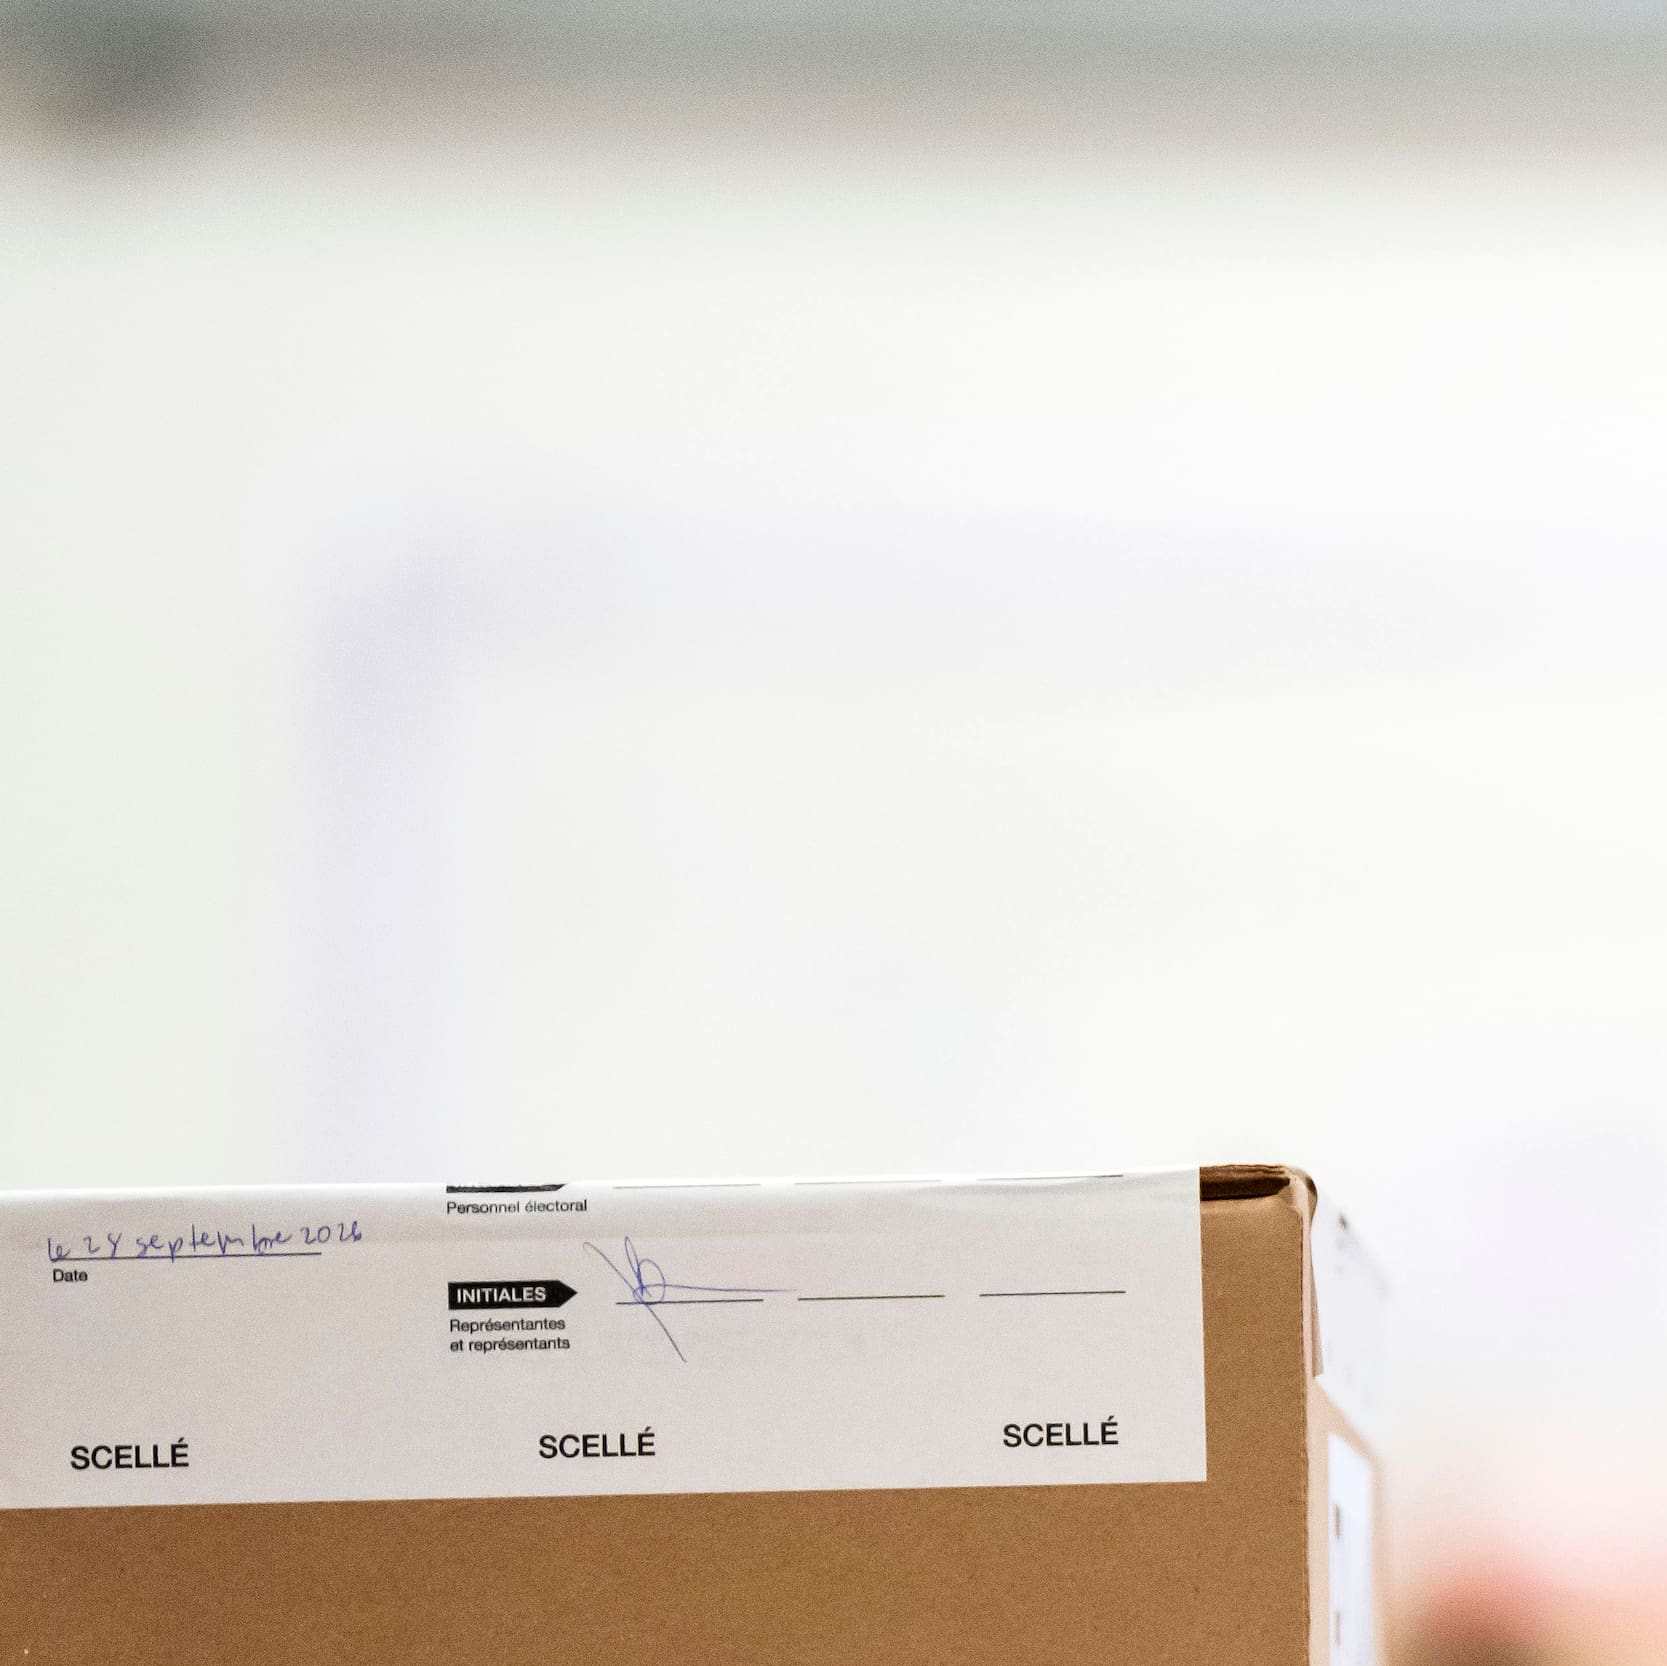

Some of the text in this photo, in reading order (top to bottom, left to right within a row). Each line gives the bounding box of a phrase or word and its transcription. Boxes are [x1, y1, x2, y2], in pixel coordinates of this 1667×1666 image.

[446, 1199, 588, 1215] Personnel électoral
[47, 1237, 72, 1263] le
[135, 1223, 292, 1264] septembre
[53, 1268, 89, 1283] Date
[456, 1286, 546, 1304] INITIALES
[449, 1317, 566, 1335] Représentantes
[449, 1336, 571, 1355] et représentants
[1003, 1415, 1119, 1448] SCELLÉ
[538, 1426, 656, 1460] SCELLÉ
[70, 1436, 190, 1471] SCELLÉ
